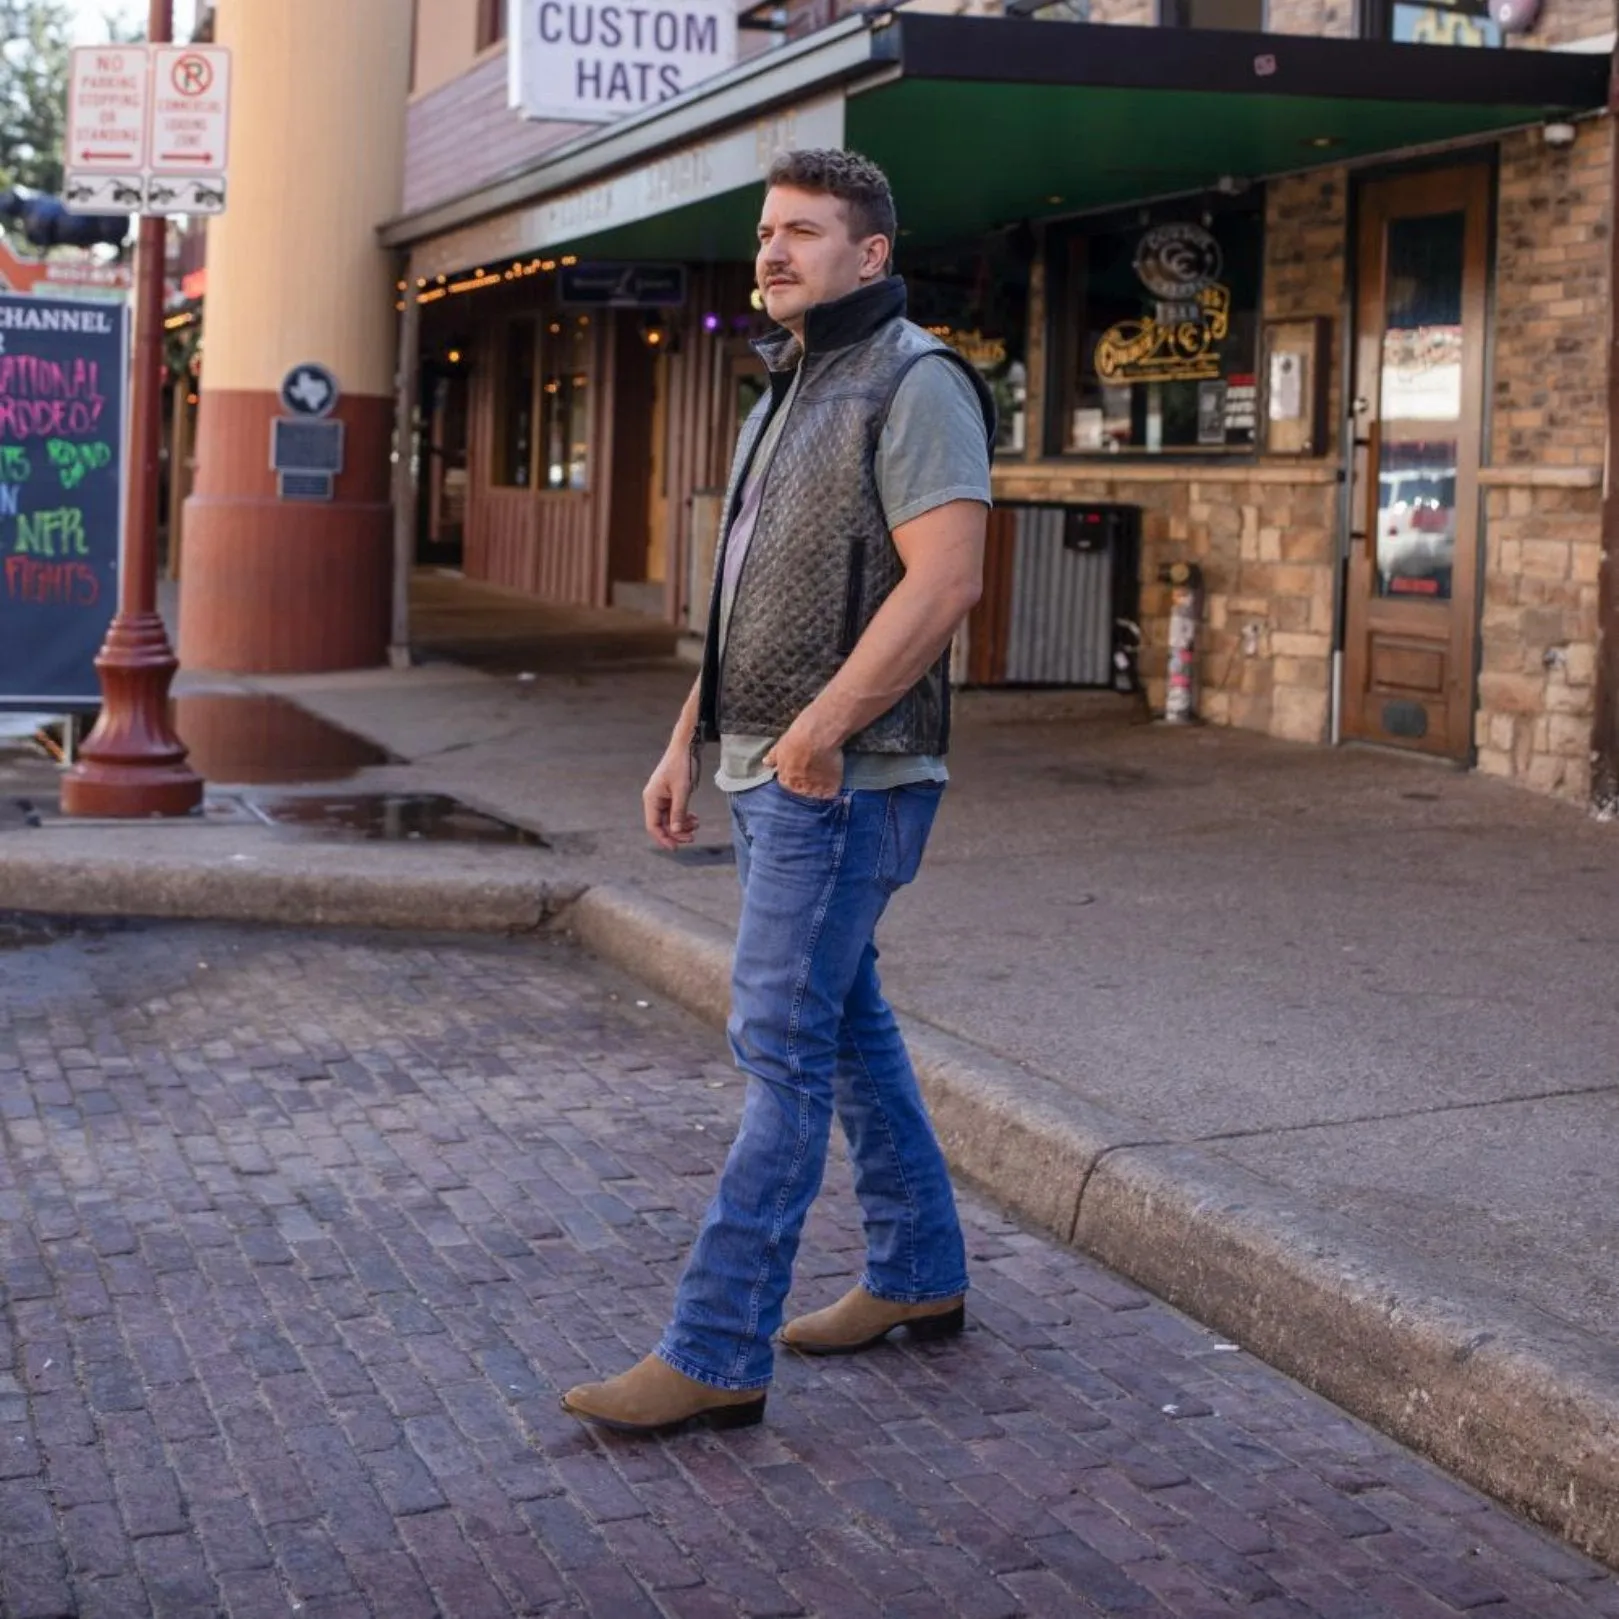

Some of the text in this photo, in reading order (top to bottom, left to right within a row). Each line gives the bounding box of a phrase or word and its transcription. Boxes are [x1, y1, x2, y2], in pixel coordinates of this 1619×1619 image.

[539, 2, 717, 54] CUSTOM
[96, 54, 124, 71] NO
[81, 76, 137, 89] PARKING
[577, 58, 681, 102] HATS
[0, 306, 112, 334] HANNEL
